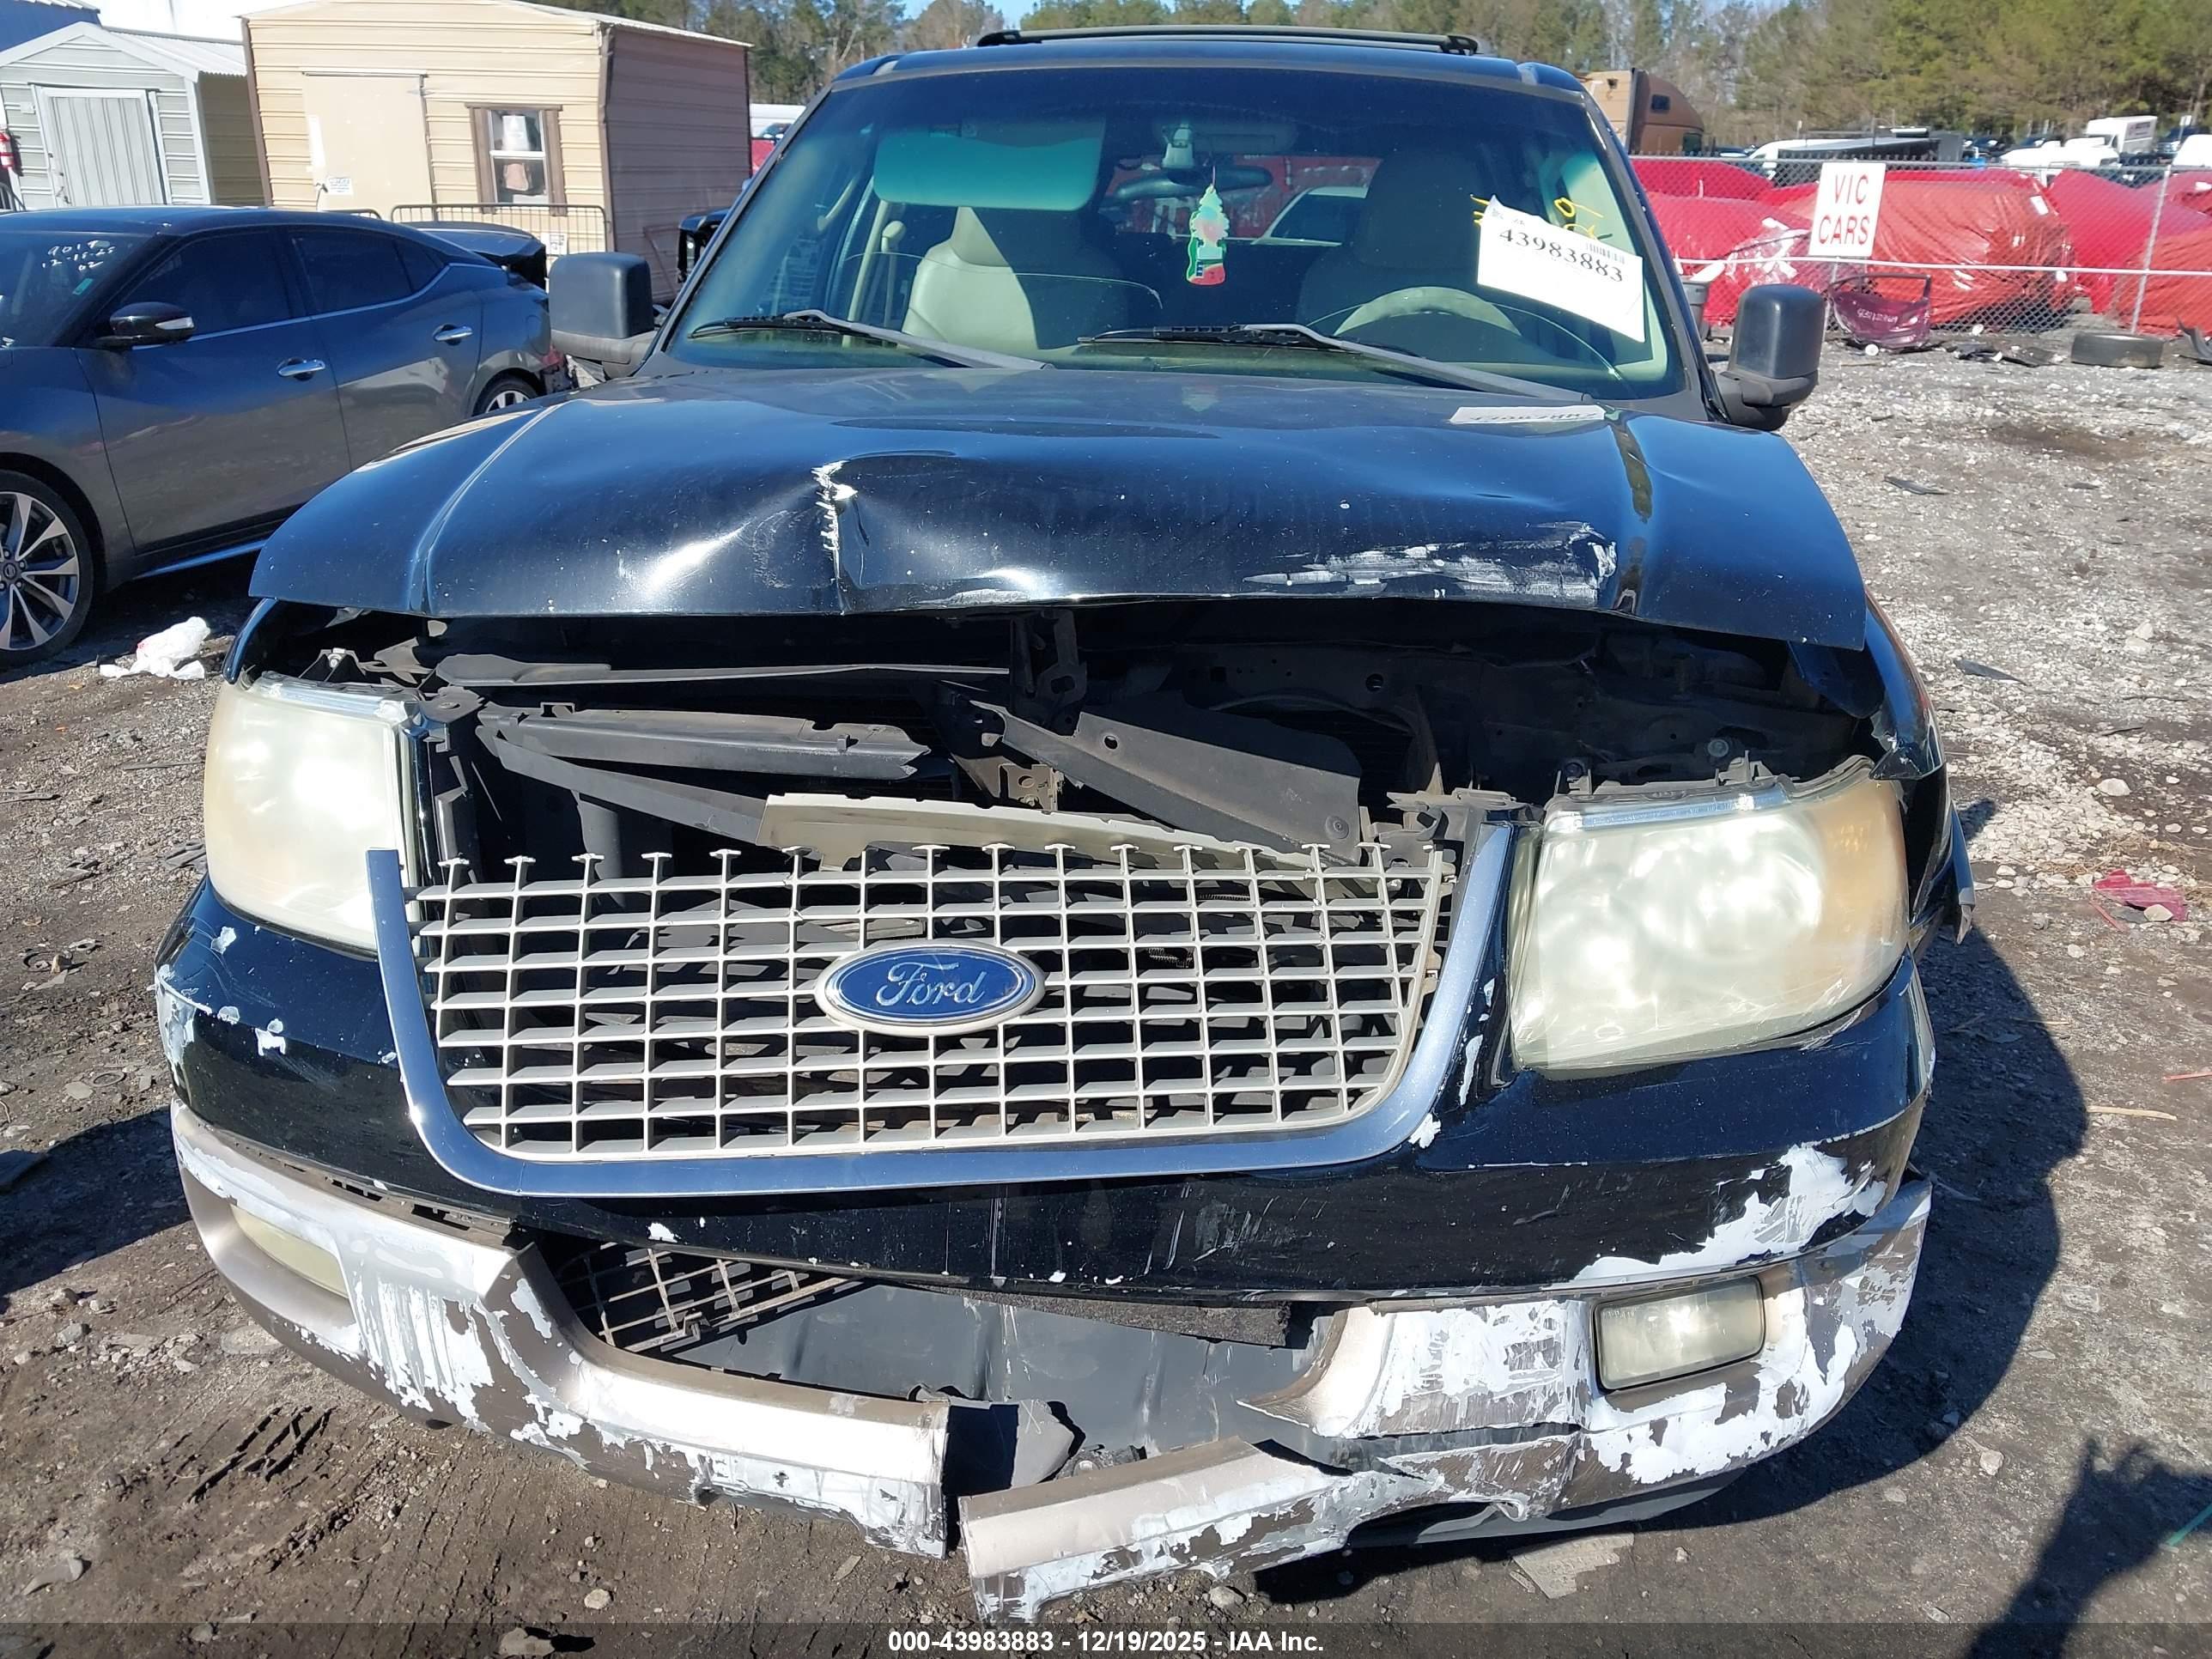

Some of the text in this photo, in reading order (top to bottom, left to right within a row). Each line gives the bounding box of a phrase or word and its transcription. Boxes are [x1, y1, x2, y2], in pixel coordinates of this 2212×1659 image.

[1835, 173, 1869, 204] VIC
[1818, 214, 1870, 246] CARS
[1498, 228, 1624, 283] 43983883
[876, 961, 988, 1006] Ford
